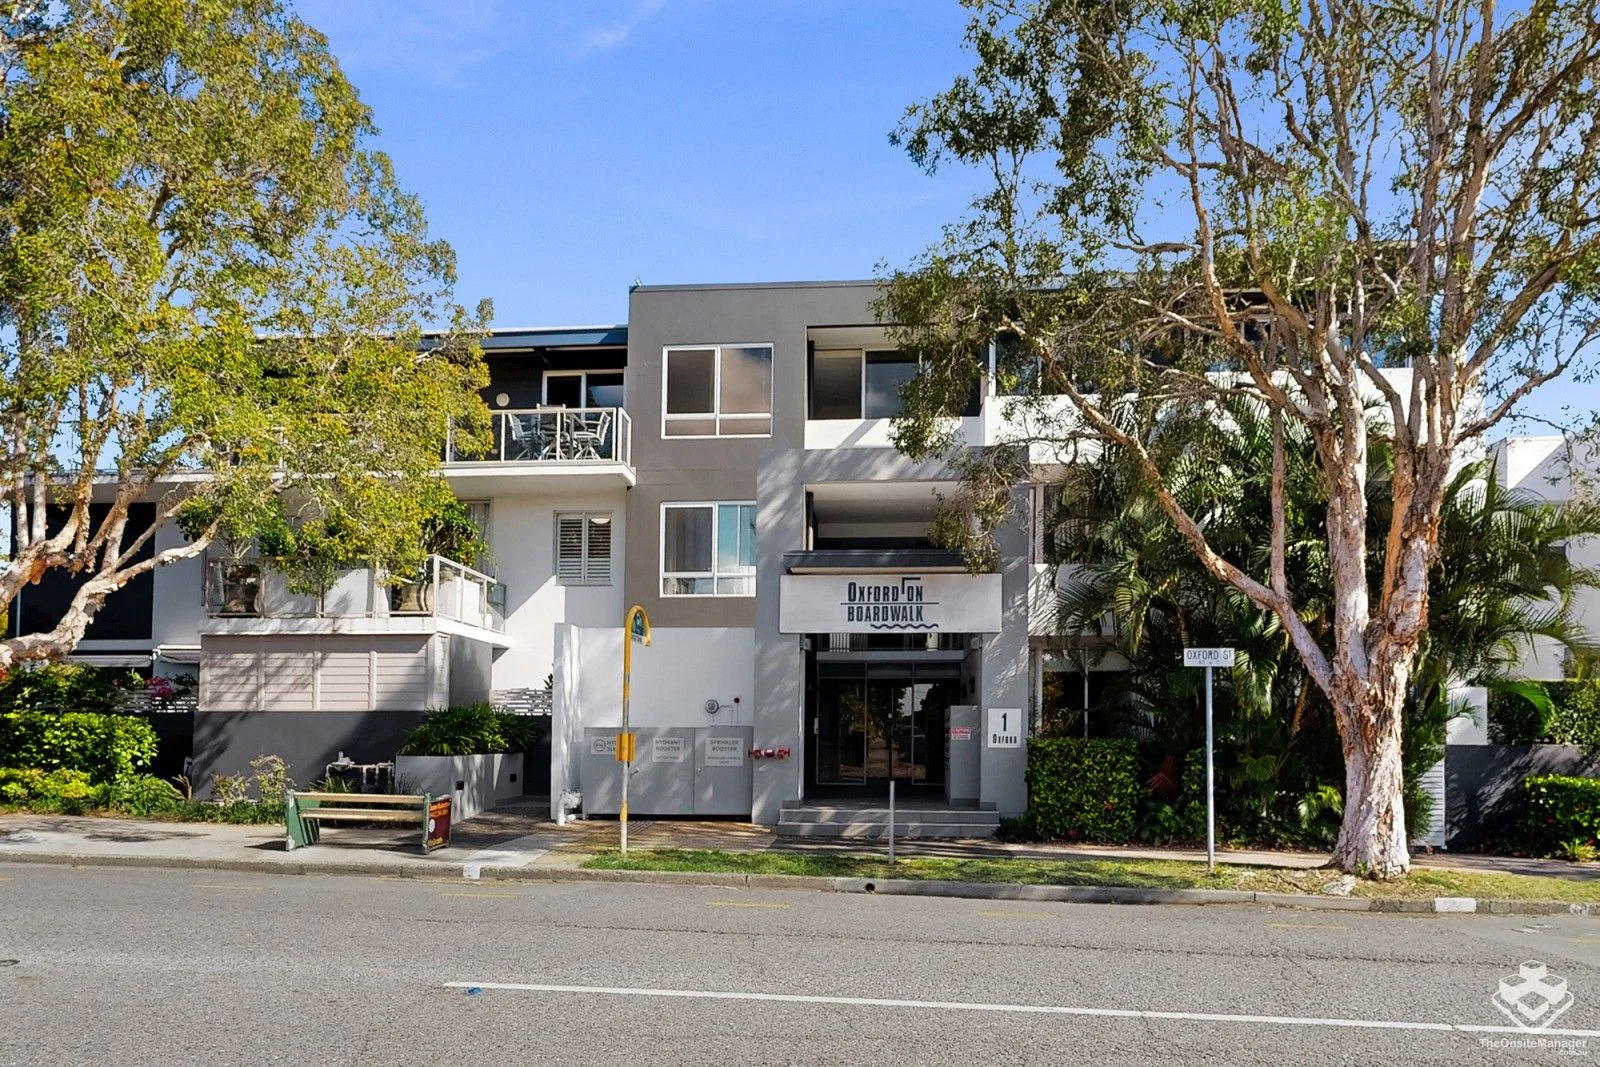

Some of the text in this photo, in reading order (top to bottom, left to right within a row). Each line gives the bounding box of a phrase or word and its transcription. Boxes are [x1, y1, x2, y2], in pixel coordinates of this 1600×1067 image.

[848, 582, 923, 602] OXFORD ON
[848, 606, 924, 622] BOARDWALK
[1187, 650, 1231, 660] OXFORD ST
[1002, 713, 1007, 731] 1
[993, 734, 1017, 744] OXFORD
